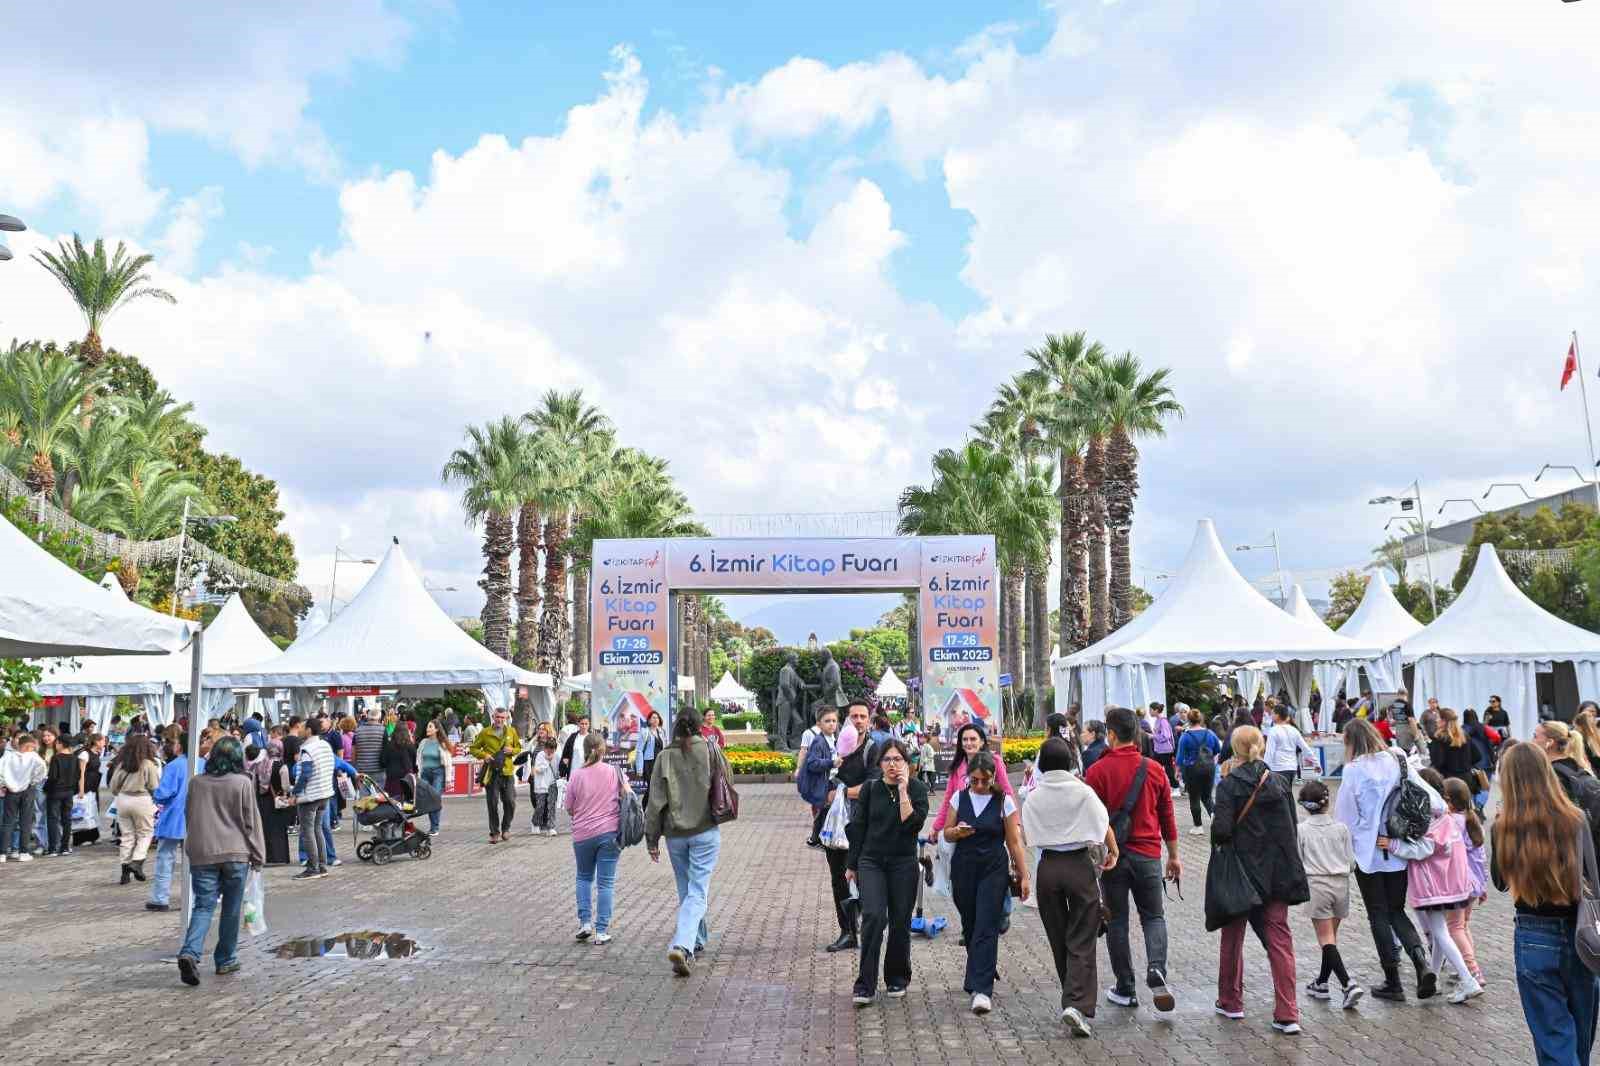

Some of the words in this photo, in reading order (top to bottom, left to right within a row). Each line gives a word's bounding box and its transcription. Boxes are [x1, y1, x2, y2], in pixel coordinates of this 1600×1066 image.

[690, 554, 706, 573] 6.
[711, 550, 765, 573] İzmir
[772, 554, 835, 575] Kitap
[842, 553, 898, 572] Fuarı
[600, 579, 614, 595] 6.
[618, 575, 662, 595] İzmir
[929, 576, 942, 592] 6.
[946, 572, 990, 592] İzmir
[606, 598, 656, 615] Kitap
[934, 594, 985, 612] Kitap
[608, 616, 654, 631] Fuarı
[937, 612, 983, 627] Fuarı
[616, 638, 647, 649] 17-26
[946, 634, 977, 646] 17-26
[603, 652, 630, 664] Ekim
[632, 652, 660, 664] 2025
[933, 648, 960, 661] Ekim
[962, 649, 990, 660] 2025
